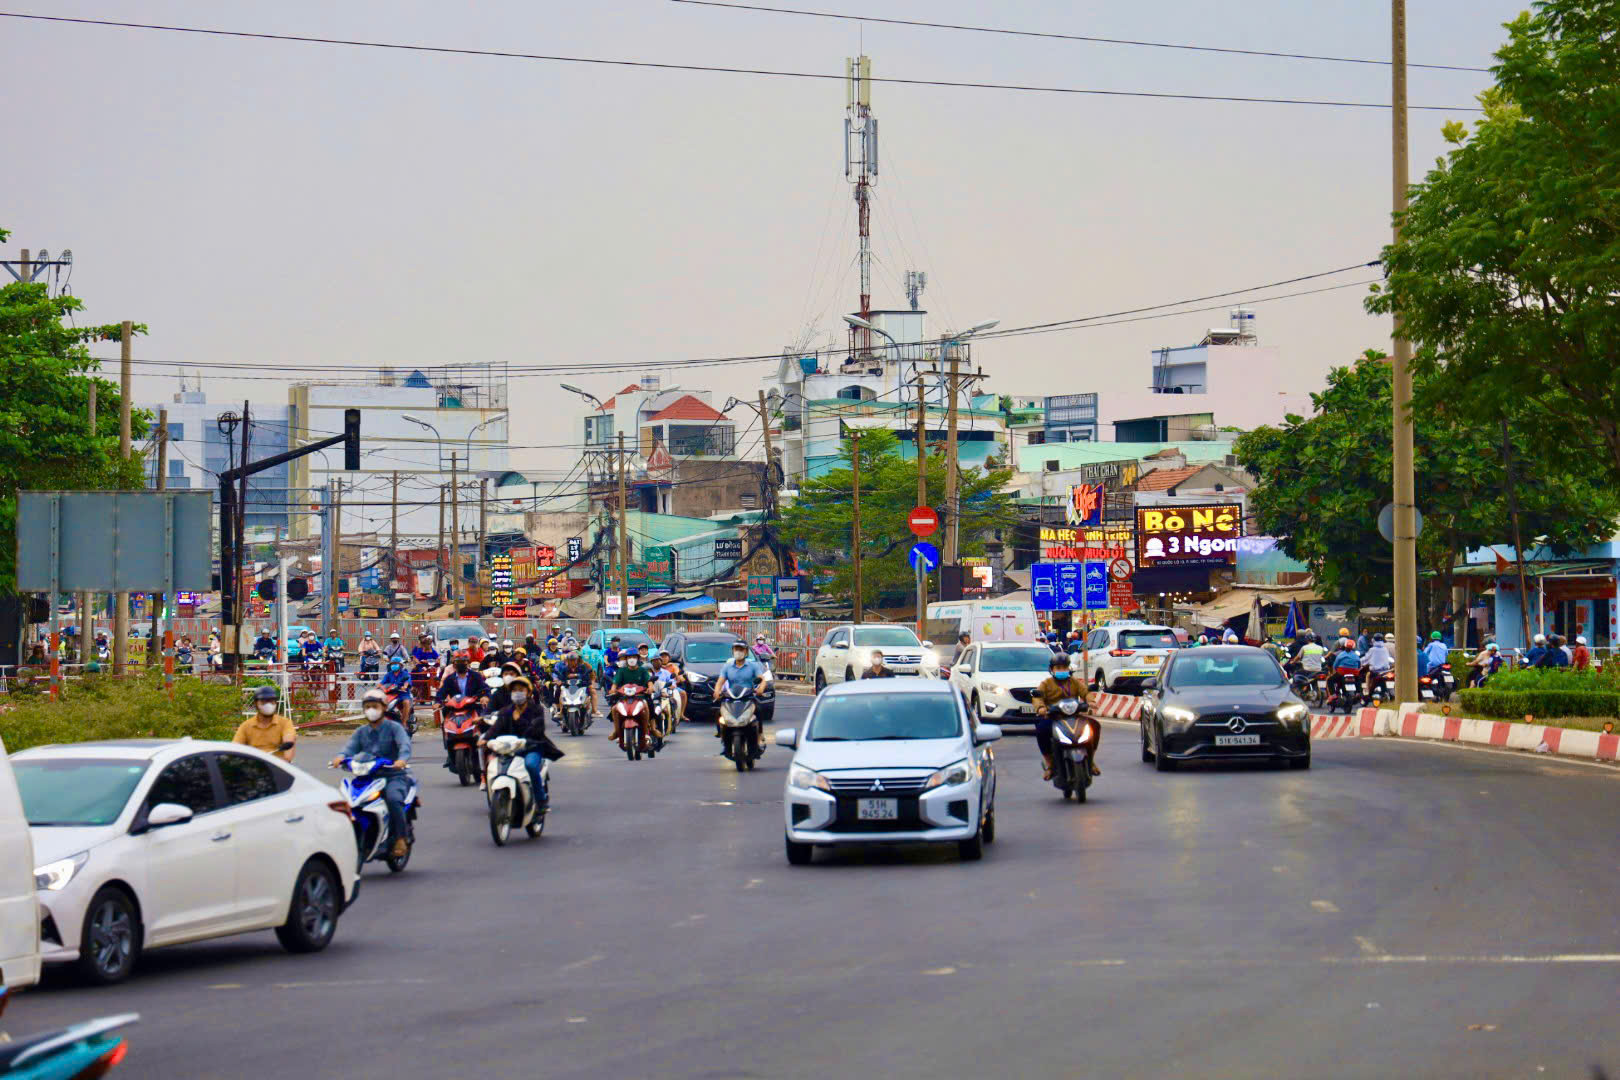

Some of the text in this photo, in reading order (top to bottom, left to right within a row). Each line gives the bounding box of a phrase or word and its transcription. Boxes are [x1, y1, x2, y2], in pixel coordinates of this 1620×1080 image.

[1144, 509, 1234, 533] Bò Né
[1168, 535, 1237, 556] 3 Ngon
[864, 799, 888, 809] 51H
